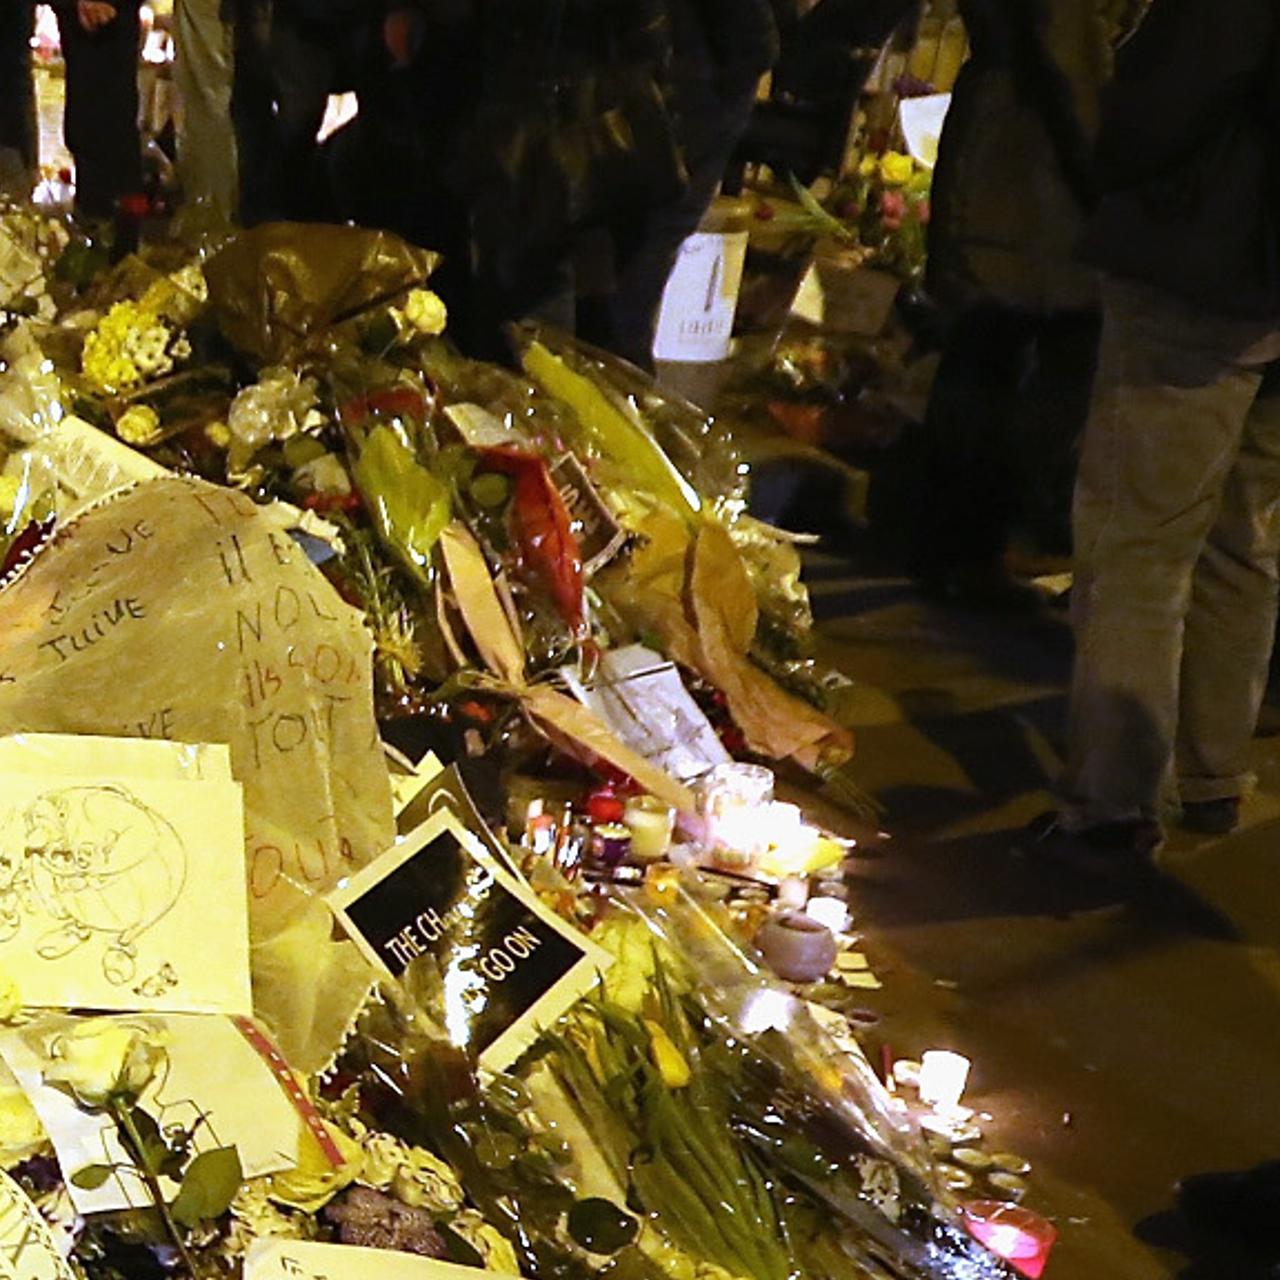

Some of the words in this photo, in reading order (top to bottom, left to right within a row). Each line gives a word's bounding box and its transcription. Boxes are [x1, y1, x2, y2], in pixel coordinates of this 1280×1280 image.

[384, 925, 427, 965] THE
[479, 947, 516, 982] GO
[504, 925, 542, 959] ON
